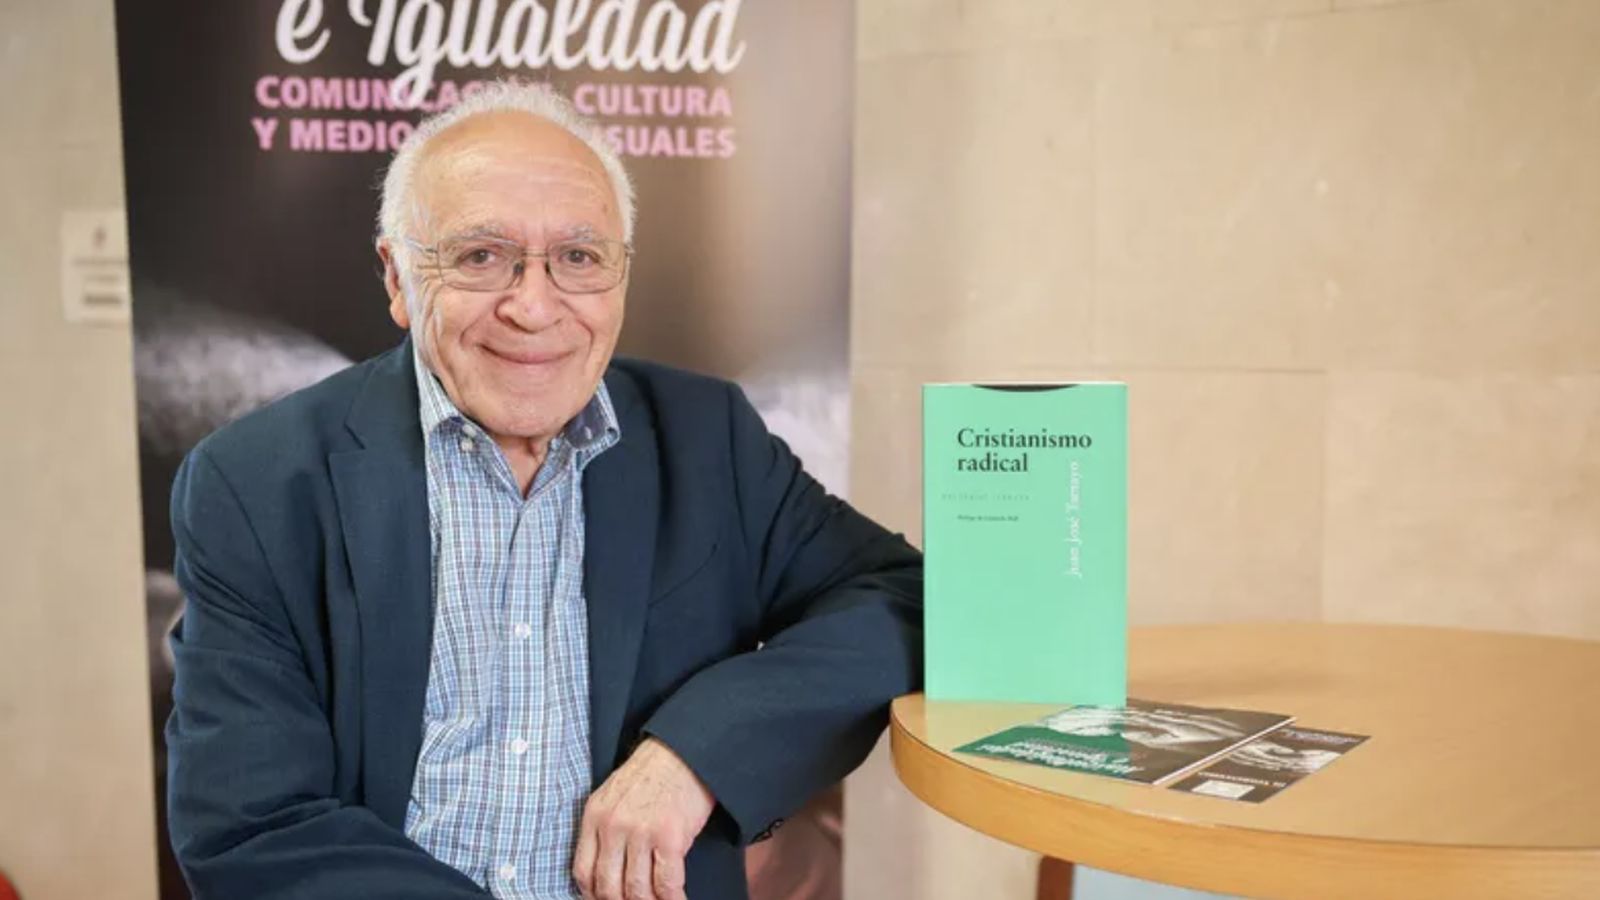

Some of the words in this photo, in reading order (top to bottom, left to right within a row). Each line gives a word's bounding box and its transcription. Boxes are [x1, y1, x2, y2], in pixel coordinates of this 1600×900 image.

[275, 0, 331, 64] e
[348, 0, 747, 108] Igualdad
[575, 82, 733, 118] CULTURA
[251, 116, 280, 151] Y
[289, 117, 414, 152] MEDIO
[957, 427, 1093, 448] Cristianismo
[957, 452, 1028, 472] radical
